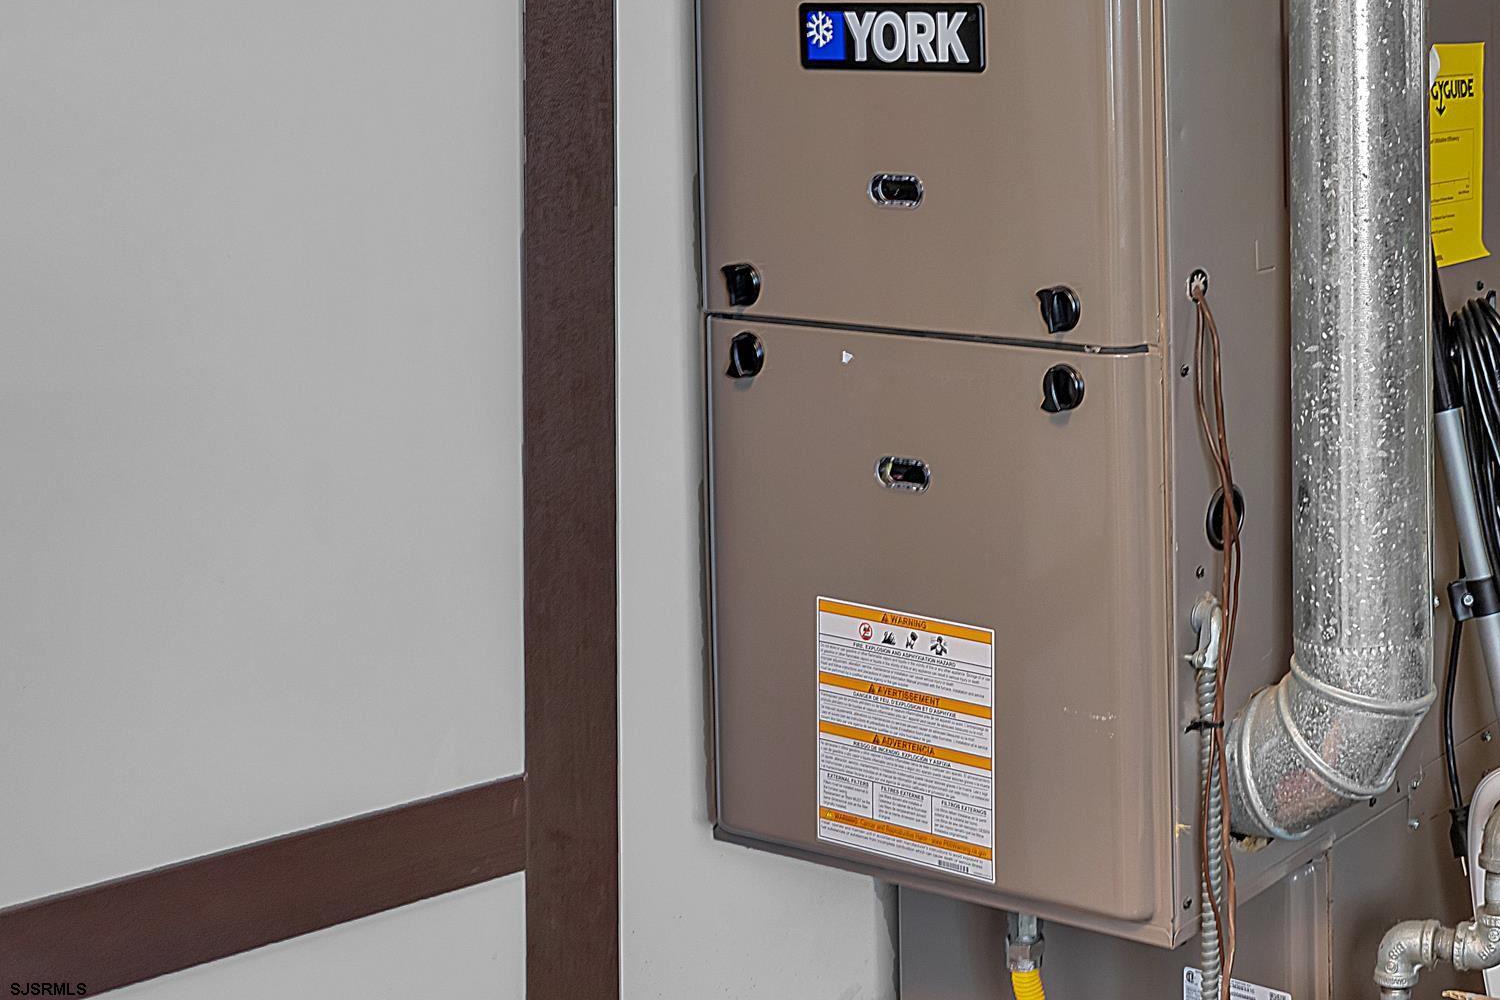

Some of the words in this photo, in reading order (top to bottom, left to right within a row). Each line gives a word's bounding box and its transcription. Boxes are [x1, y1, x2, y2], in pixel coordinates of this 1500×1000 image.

[844, 10, 970, 64] YORK
[891, 615, 927, 630] WARNING
[936, 659, 956, 668] HAZARD
[877, 686, 940, 706] AVERTISSEMENT
[882, 736, 935, 755] ADVERTENCIA
[827, 772, 850, 782] EXTERNAL
[850, 778, 869, 787] FILTERS
[900, 790, 924, 801] EXTERNES
[941, 800, 960, 810] FILTROS
[961, 804, 987, 816] EXTERNOS
